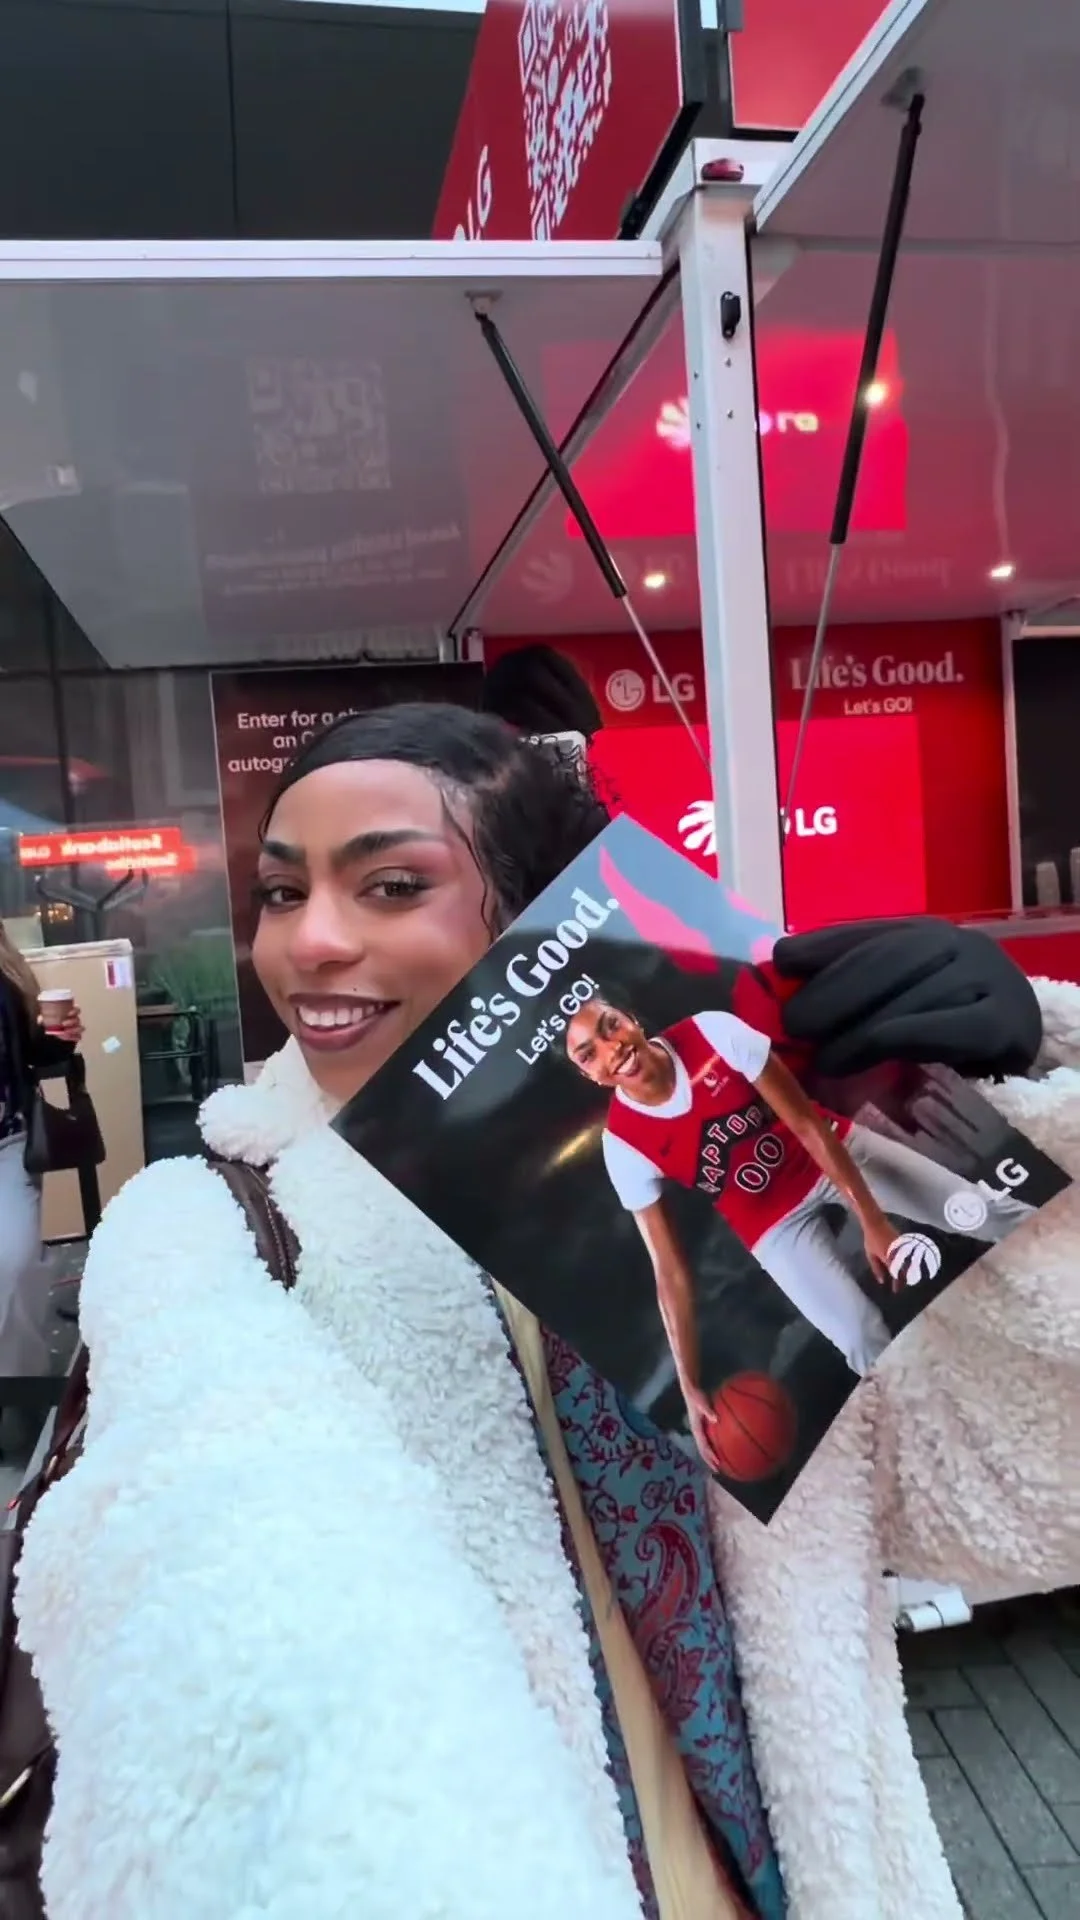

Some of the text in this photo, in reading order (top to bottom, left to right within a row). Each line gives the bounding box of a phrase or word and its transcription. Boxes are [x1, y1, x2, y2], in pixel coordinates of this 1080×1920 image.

[872, 652, 964, 686] Good.
[652, 672, 695, 703] LG
[237, 711, 287, 729] Enter
[290, 709, 318, 727] for
[321, 711, 333, 725] a
[273, 734, 297, 749] an
[798, 806, 837, 837] LG
[412, 887, 620, 1100] Life's Good.
[516, 973, 600, 1065] Let's GO!
[735, 1133, 784, 1193] 00
[978, 1157, 1030, 1201] LG
